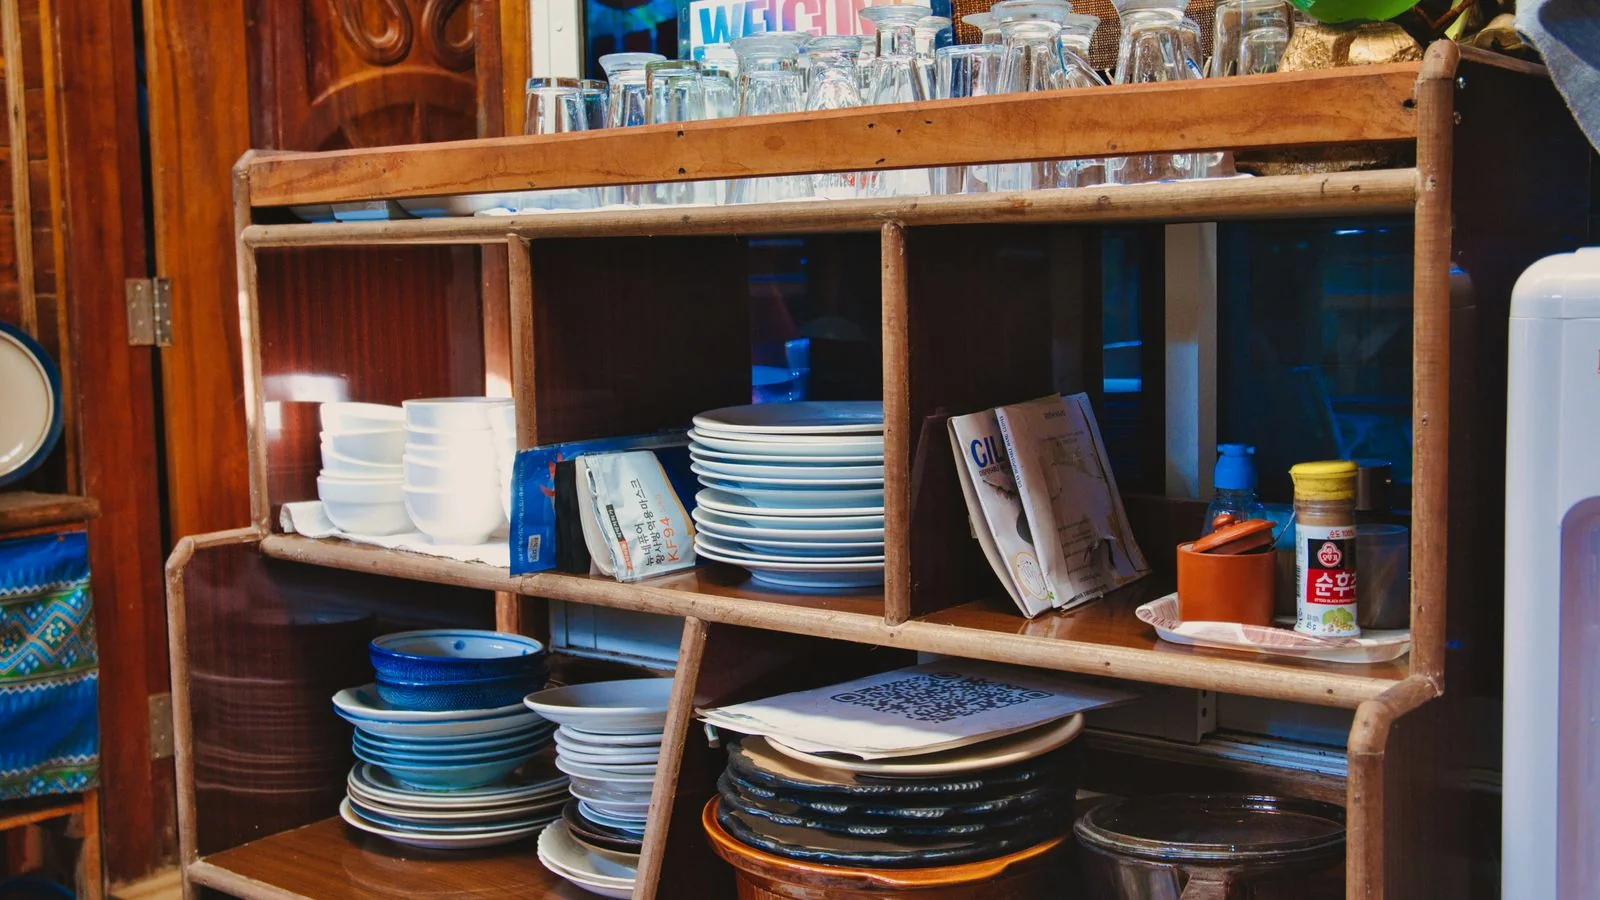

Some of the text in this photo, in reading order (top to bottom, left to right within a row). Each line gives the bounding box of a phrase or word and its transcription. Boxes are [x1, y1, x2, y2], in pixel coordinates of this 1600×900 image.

[630, 478, 665, 565] 황사방역용마스크
[660, 516, 679, 562] KF94
[634, 523, 654, 567] 뉴네퓨어
